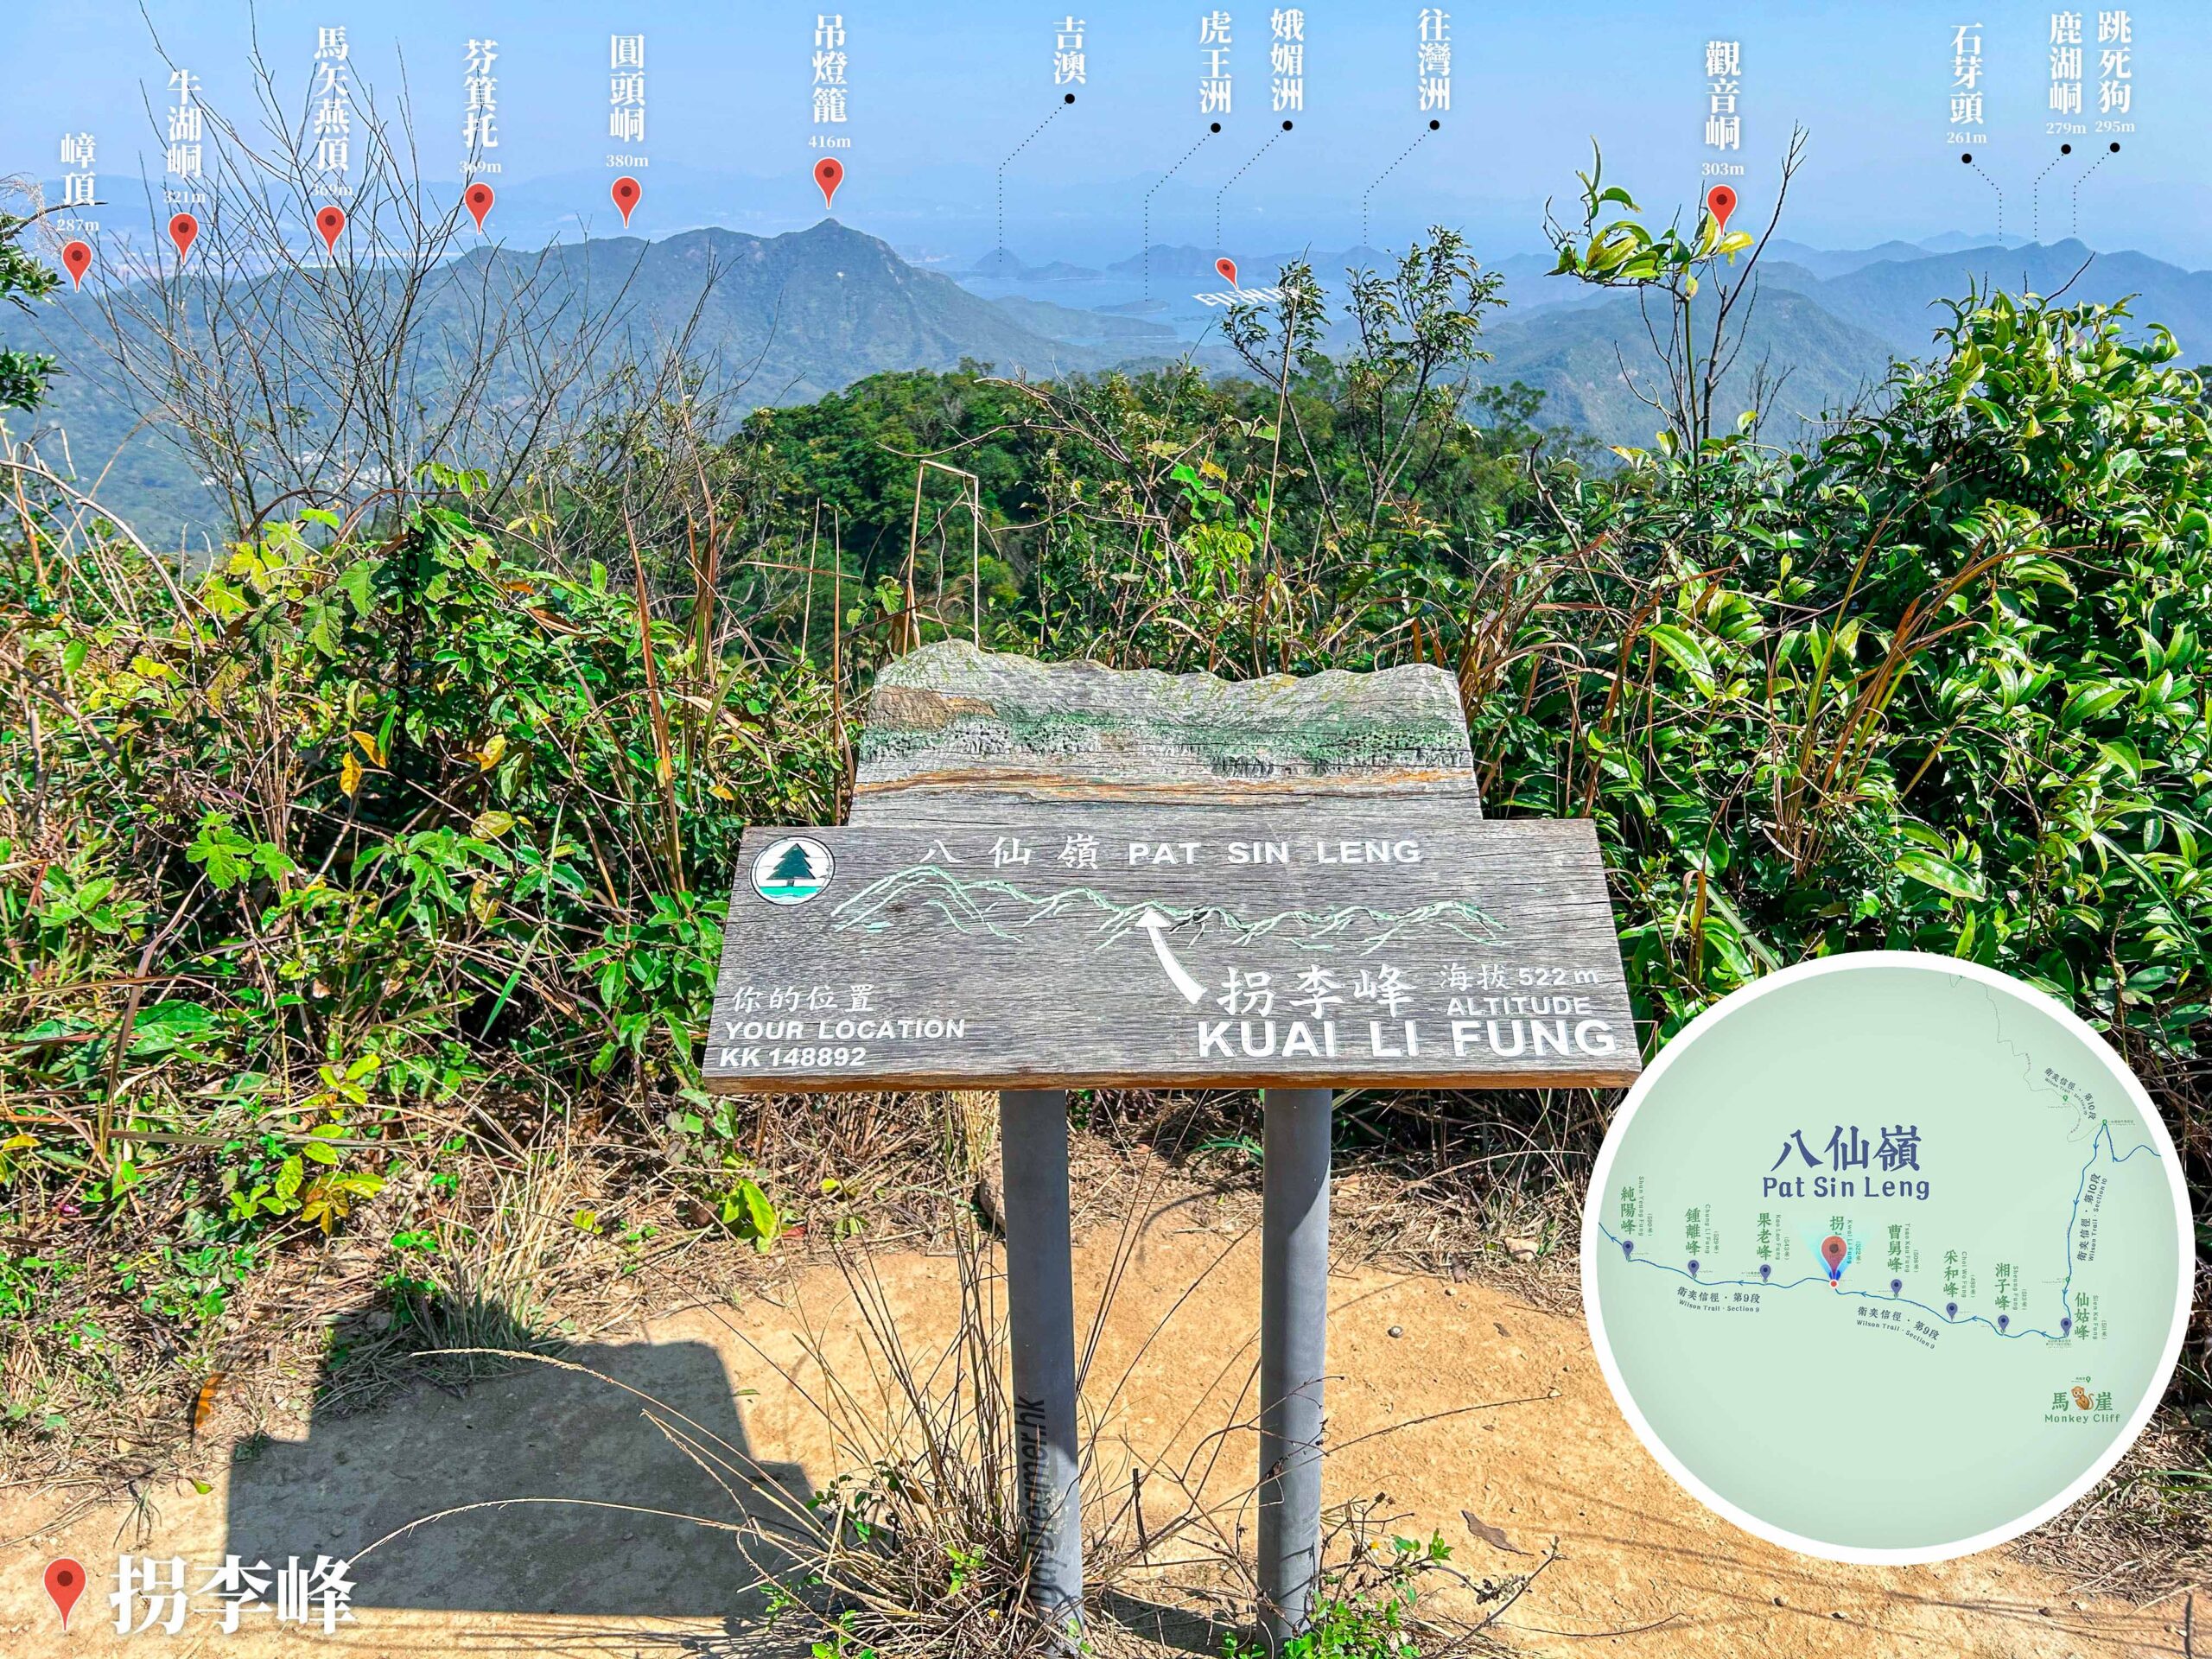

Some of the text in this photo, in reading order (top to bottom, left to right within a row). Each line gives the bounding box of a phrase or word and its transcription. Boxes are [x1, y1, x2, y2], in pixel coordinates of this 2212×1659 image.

[918, 835, 1422, 870] 八仙嶺 PAT SIN LENG
[1216, 963, 1418, 1020] 拐李峰
[1439, 963, 1601, 992] 海拔 522 m
[733, 983, 875, 1014] 你的位置
[1446, 996, 1594, 1017] ALTITUDE
[725, 1018, 966, 1041] YOUR LOCATION
[1198, 1018, 1618, 1058] KUAI LI FUNG
[719, 1046, 867, 1068] KK 148892
